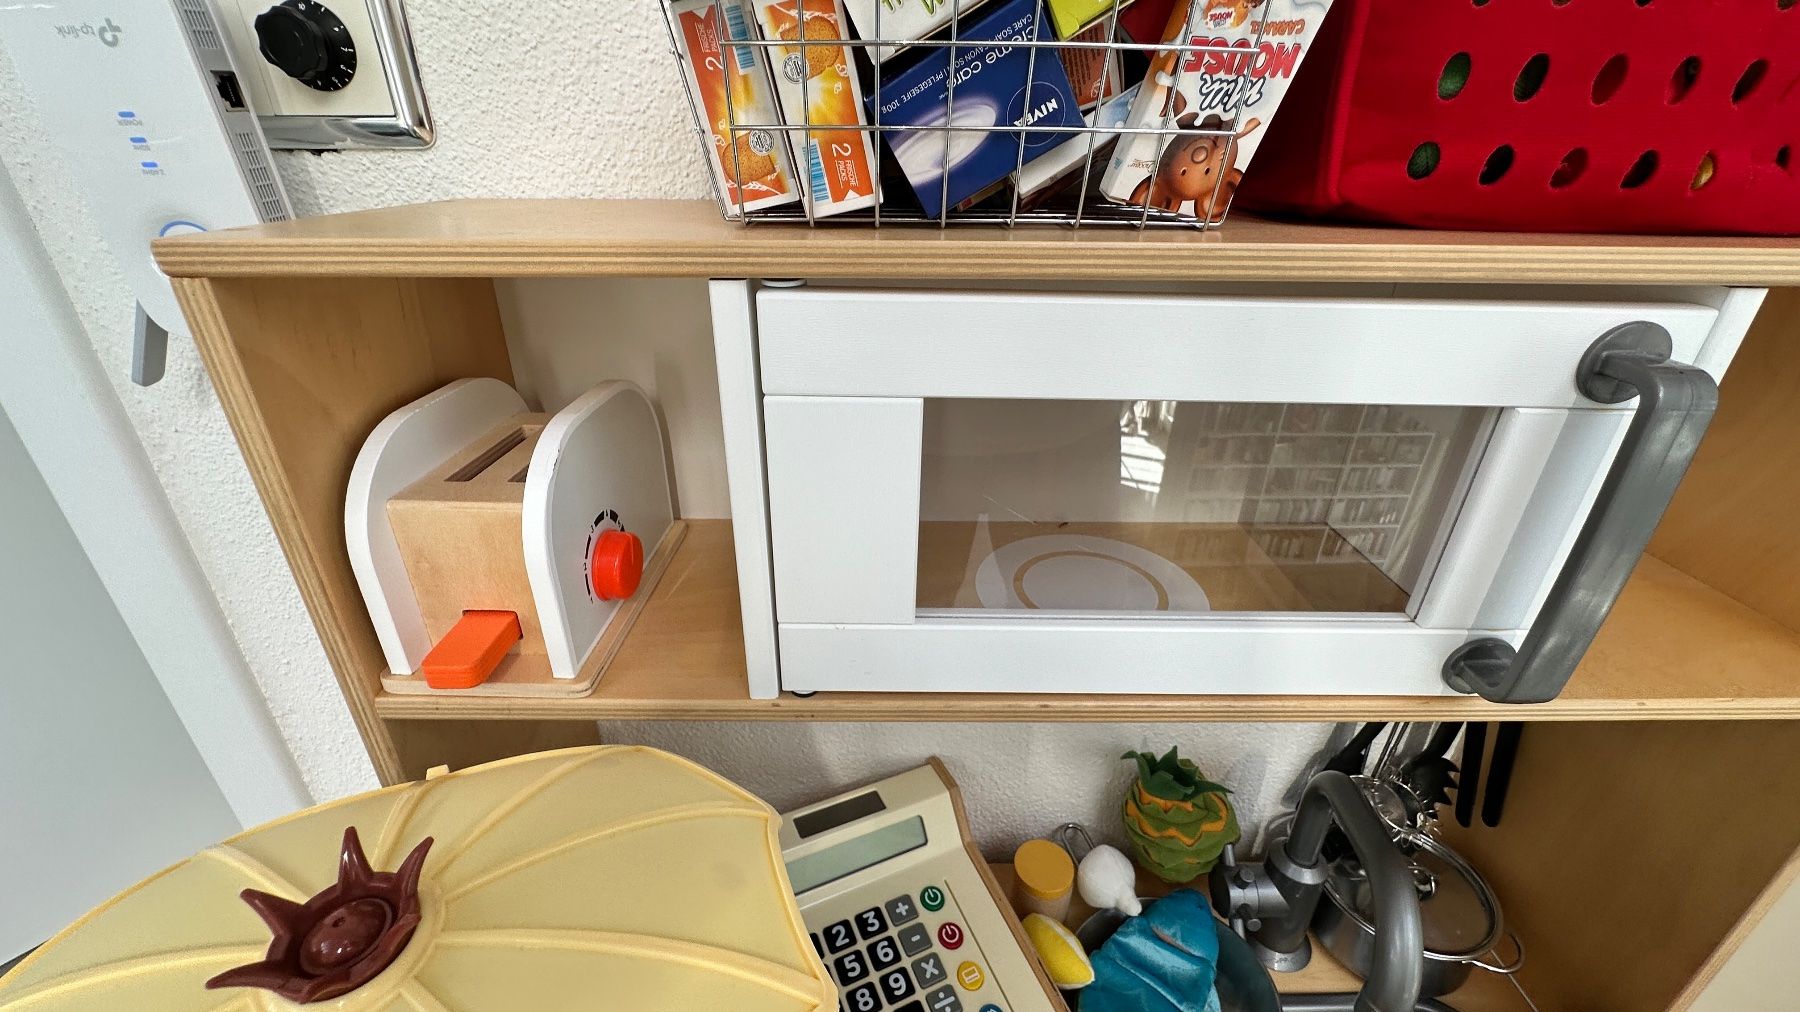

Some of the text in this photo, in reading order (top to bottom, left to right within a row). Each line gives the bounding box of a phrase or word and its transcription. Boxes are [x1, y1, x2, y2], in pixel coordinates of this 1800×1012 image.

[1014, 13, 1033, 32] CARE
[705, 56, 724, 71] 2
[1184, 35, 1302, 80] MOUSE
[900, 70, 944, 103] PFLEGESEIFE
[1199, 73, 1266, 113] Milk
[881, 98, 901, 114] 100g
[1013, 98, 1059, 127] NIVEA
[831, 143, 852, 157] 2
[837, 160, 849, 182] PACKS
[844, 160, 858, 187] FRISCHE
[831, 925, 850, 947] 2
[862, 910, 880, 932] 3
[843, 954, 861, 977] 5
[876, 940, 894, 963] 6
[855, 988, 874, 1012] 8
[888, 972, 906, 996] 9
